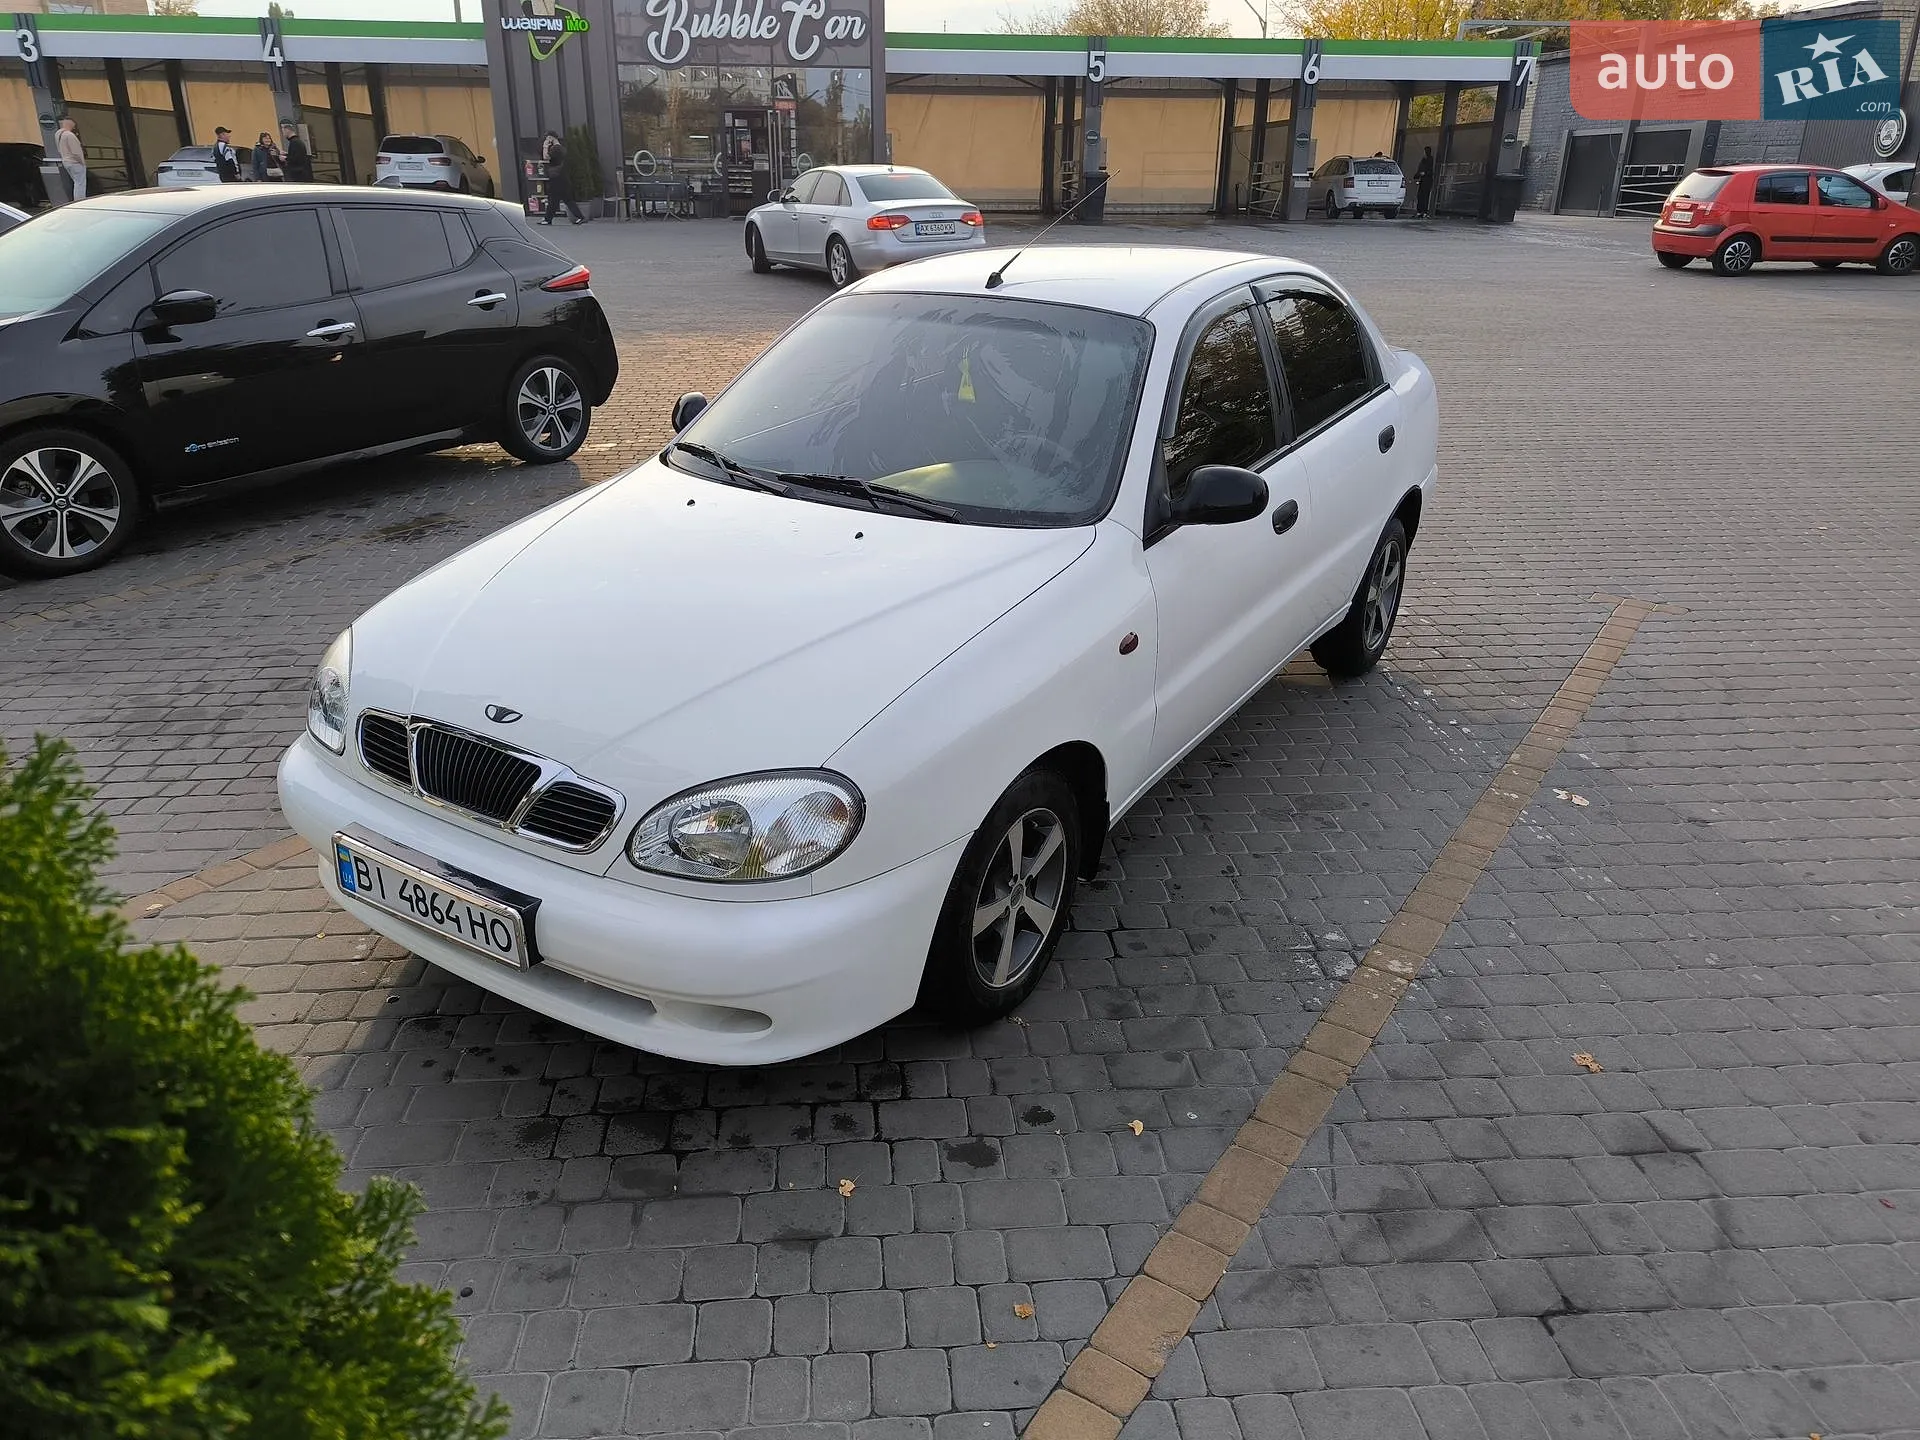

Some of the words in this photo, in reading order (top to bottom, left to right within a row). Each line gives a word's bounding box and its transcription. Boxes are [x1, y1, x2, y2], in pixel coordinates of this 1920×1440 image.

[16, 29, 39, 62] 3
[646, 0, 780, 64] Bubble
[781, 0, 866, 61] Car
[263, 33, 284, 67] 4
[1088, 51, 1105, 83] 5
[1303, 54, 1320, 85] 6
[1515, 56, 1534, 87] 7
[342, 872, 354, 885] UA
[354, 856, 386, 899] BI
[398, 878, 462, 933] 4864
[466, 906, 512, 952] HO
